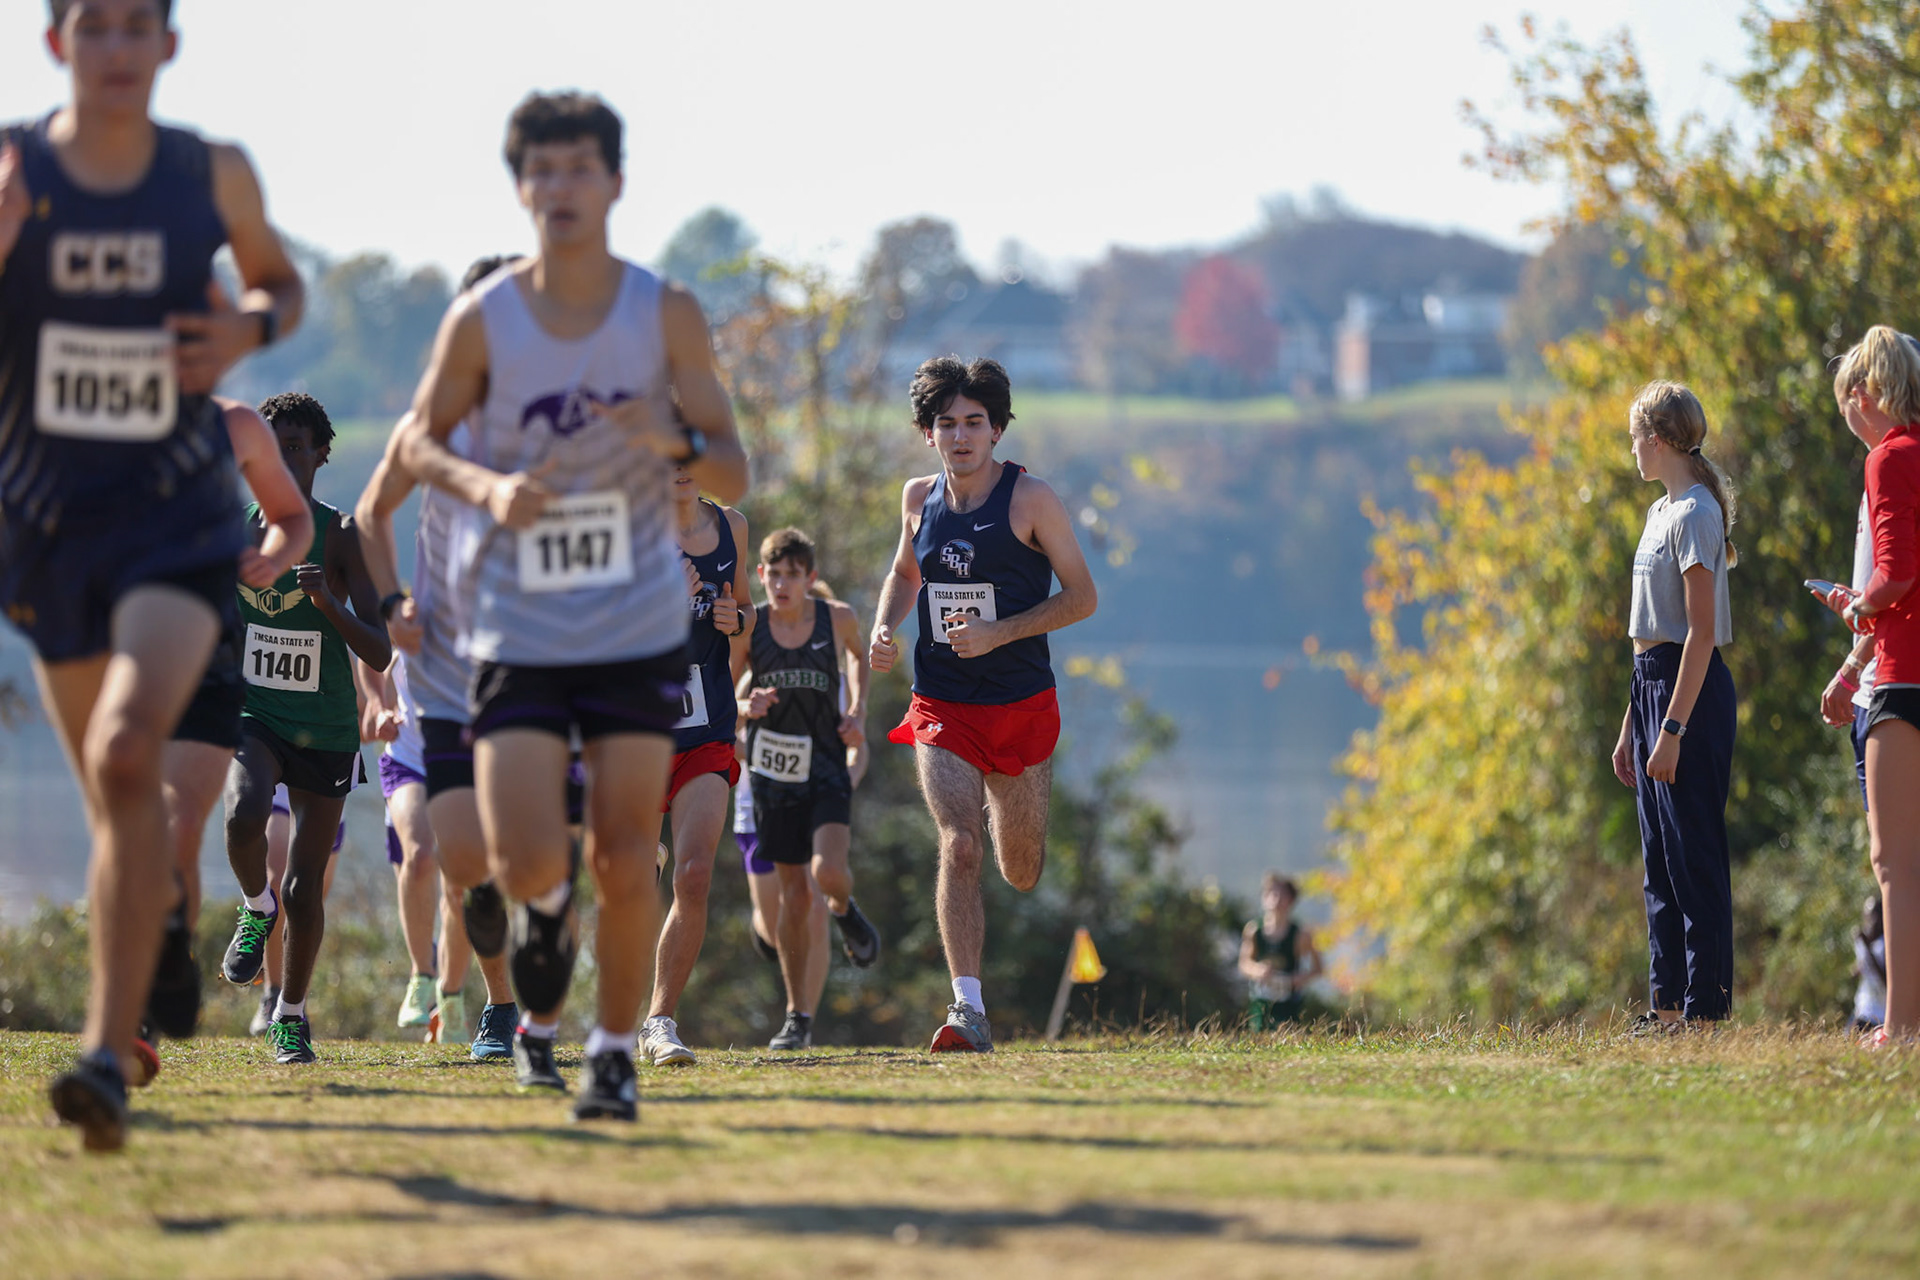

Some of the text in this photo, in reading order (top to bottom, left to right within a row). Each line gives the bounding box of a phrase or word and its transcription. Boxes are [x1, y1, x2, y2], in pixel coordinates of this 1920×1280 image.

[53, 233, 164, 294] CCS
[54, 370, 161, 419] 1054
[538, 528, 612, 574] 1147
[941, 546, 969, 576] SBA
[934, 590, 986, 601] TSSAA STATE XC
[254, 631, 315, 647] TMSAA STATE XC
[252, 648, 312, 682] 1140
[758, 668, 830, 692] WEBB
[761, 748, 799, 775] 592
